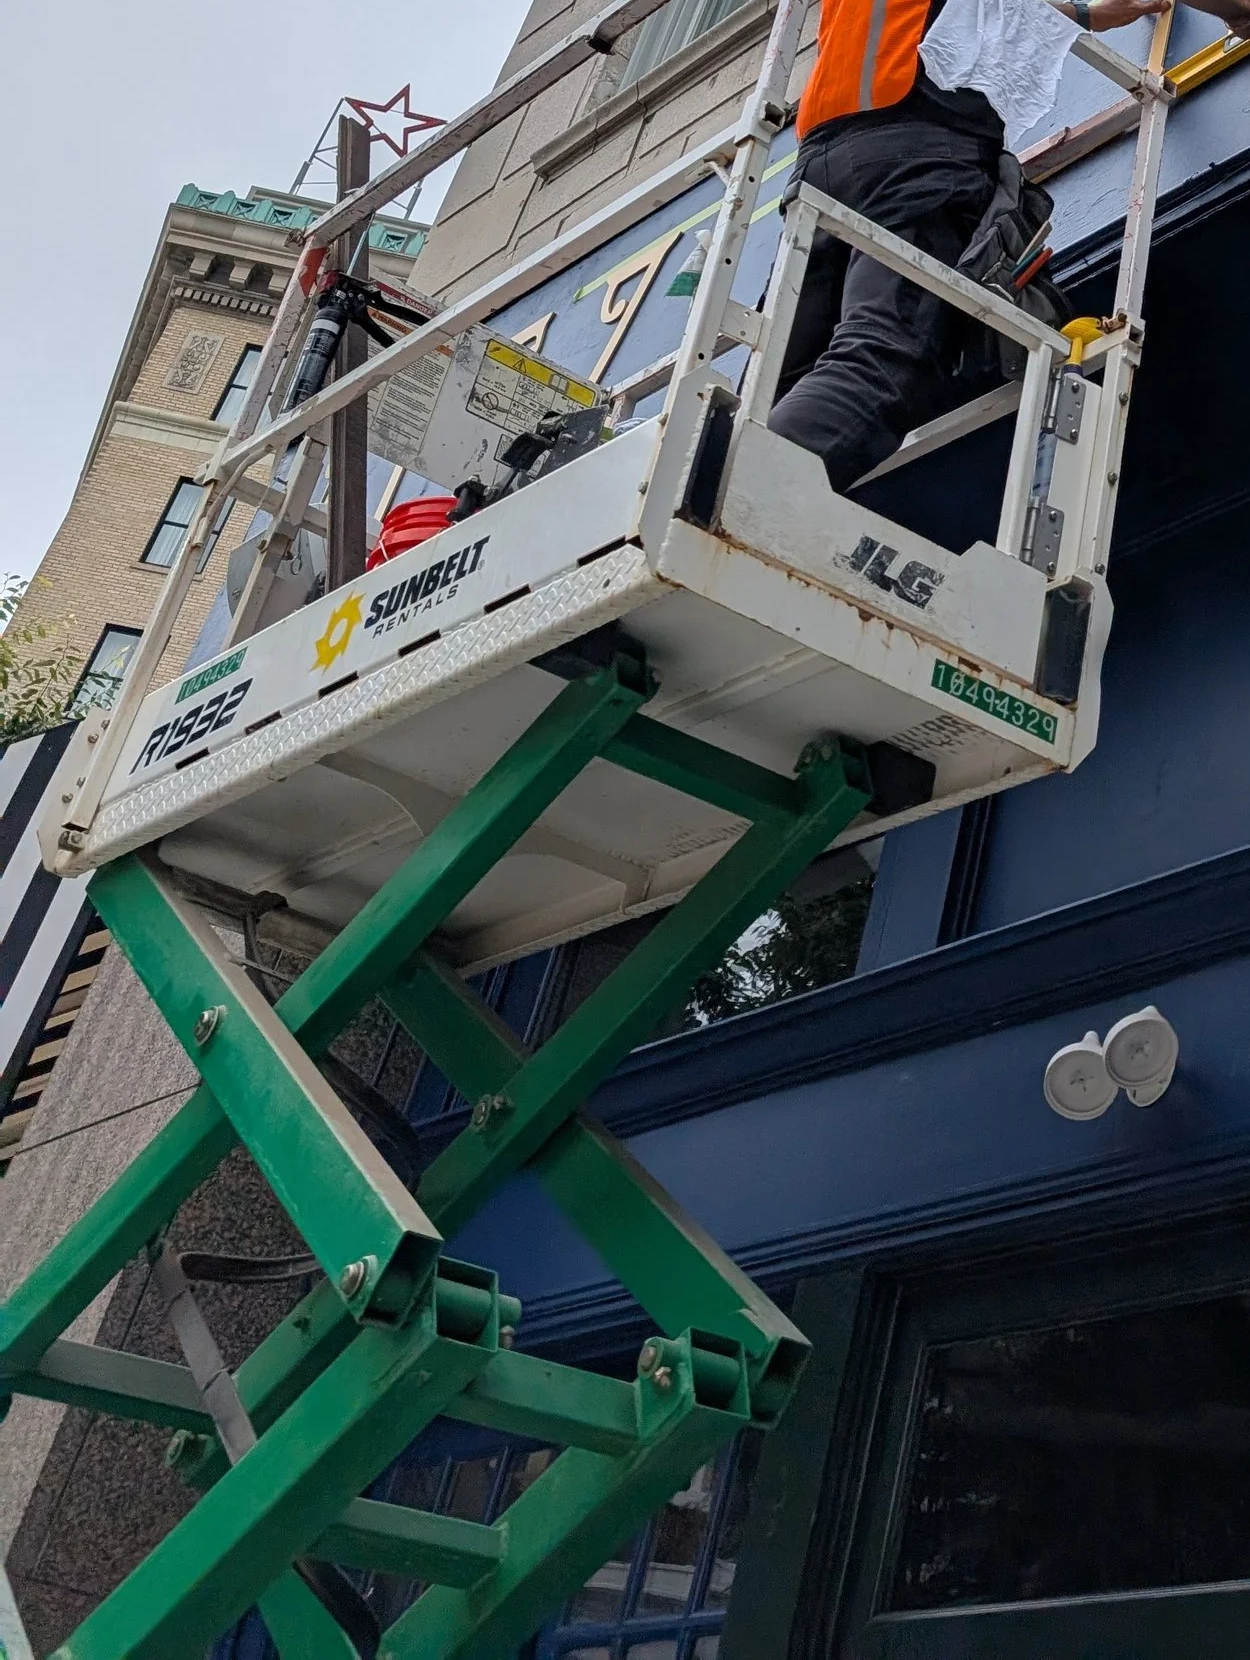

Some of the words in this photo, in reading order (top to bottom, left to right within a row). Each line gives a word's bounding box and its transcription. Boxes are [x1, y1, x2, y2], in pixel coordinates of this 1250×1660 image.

[364, 535, 490, 629] SUNBELT
[372, 585, 458, 639] RENTALS
[180, 650, 245, 701] 10494329
[937, 664, 1056, 739] 10494329
[129, 678, 253, 775] R1932
